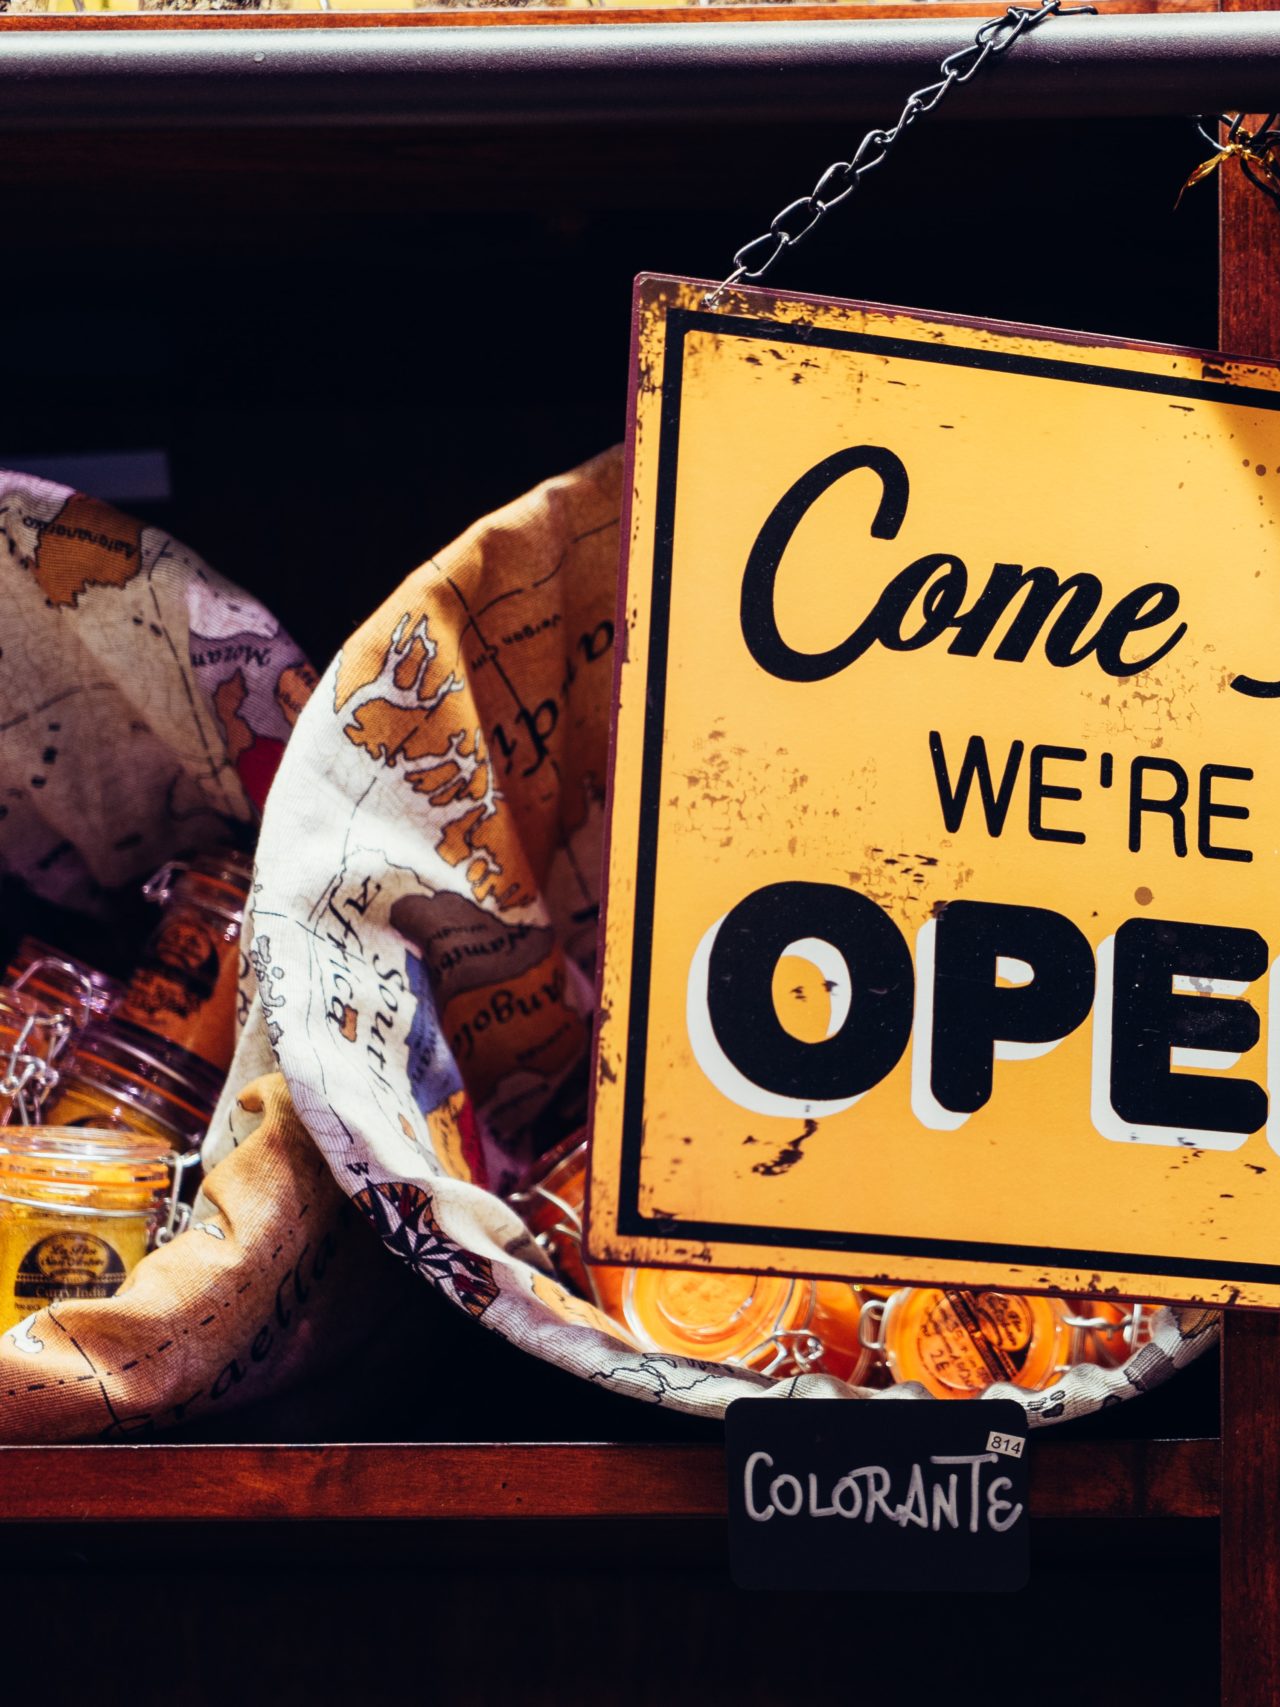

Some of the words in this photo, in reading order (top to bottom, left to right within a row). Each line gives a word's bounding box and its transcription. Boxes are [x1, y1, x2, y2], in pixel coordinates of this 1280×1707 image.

[740, 444, 1188, 683] Come
[928, 730, 1254, 862] WE'RE
[744, 1451, 1023, 1534] COLORANTE
[990, 1435, 1022, 1455] 814
